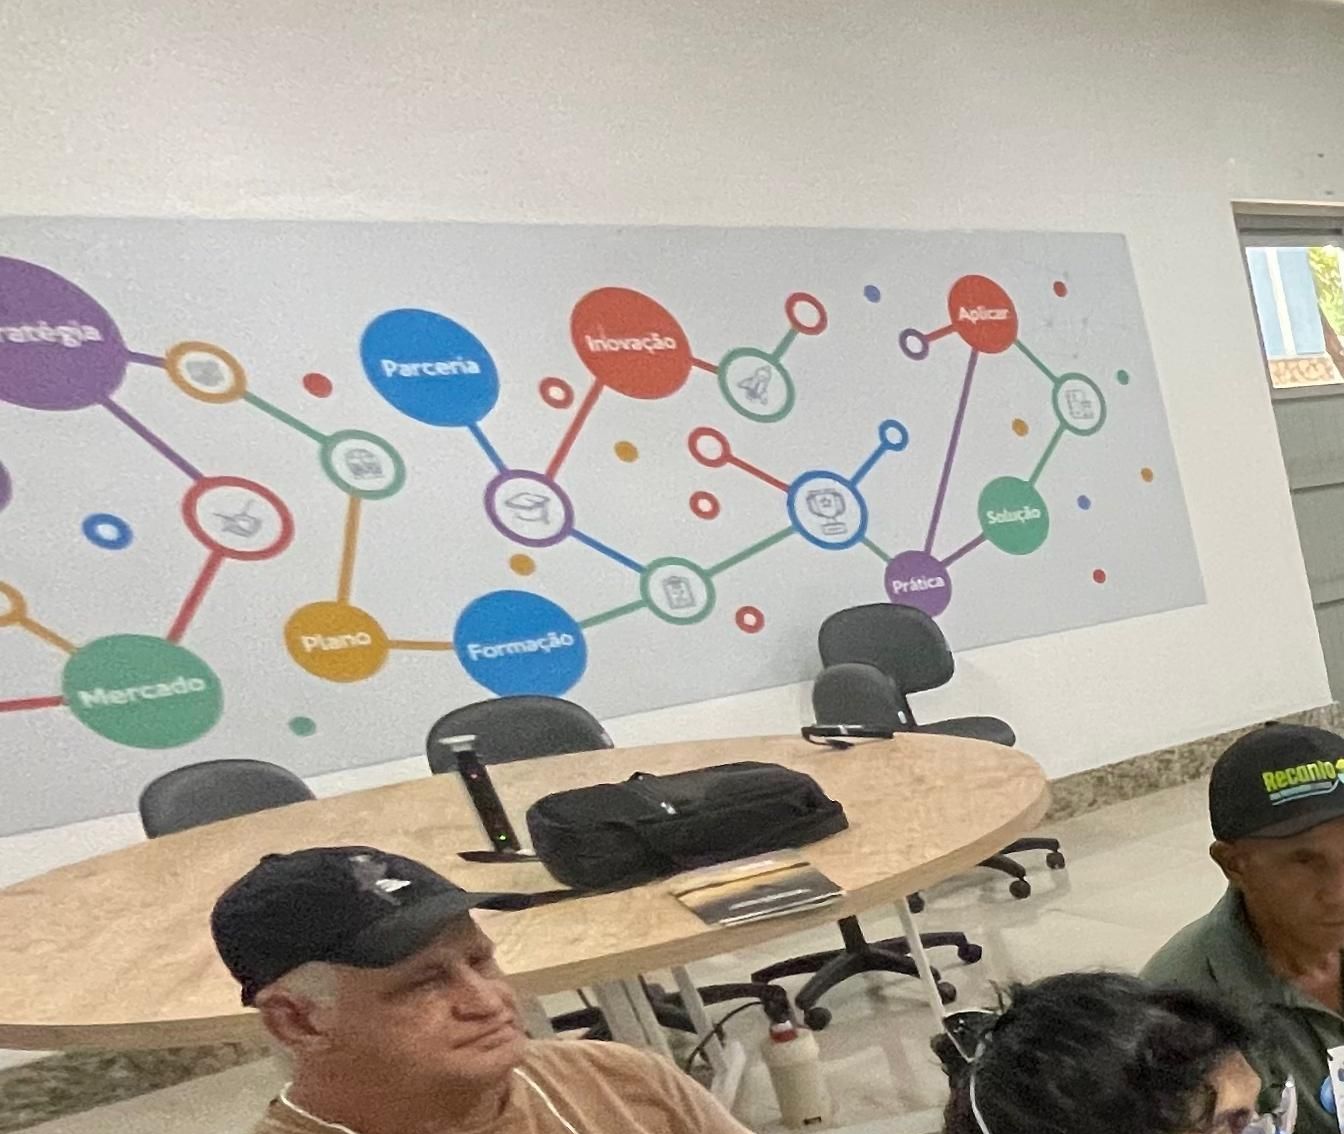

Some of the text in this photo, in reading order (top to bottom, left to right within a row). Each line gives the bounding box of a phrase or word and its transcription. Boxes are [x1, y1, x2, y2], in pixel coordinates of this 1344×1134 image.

[958, 305, 1009, 324] Aplicar
[585, 332, 677, 355] Inovação
[381, 356, 480, 378] Parceria
[986, 505, 1040, 524] Solução
[891, 573, 946, 593] Prática
[302, 629, 372, 651] Plano
[467, 631, 574, 661] Formação
[78, 674, 205, 707] Mercado
[1262, 761, 1336, 792] Recanto
